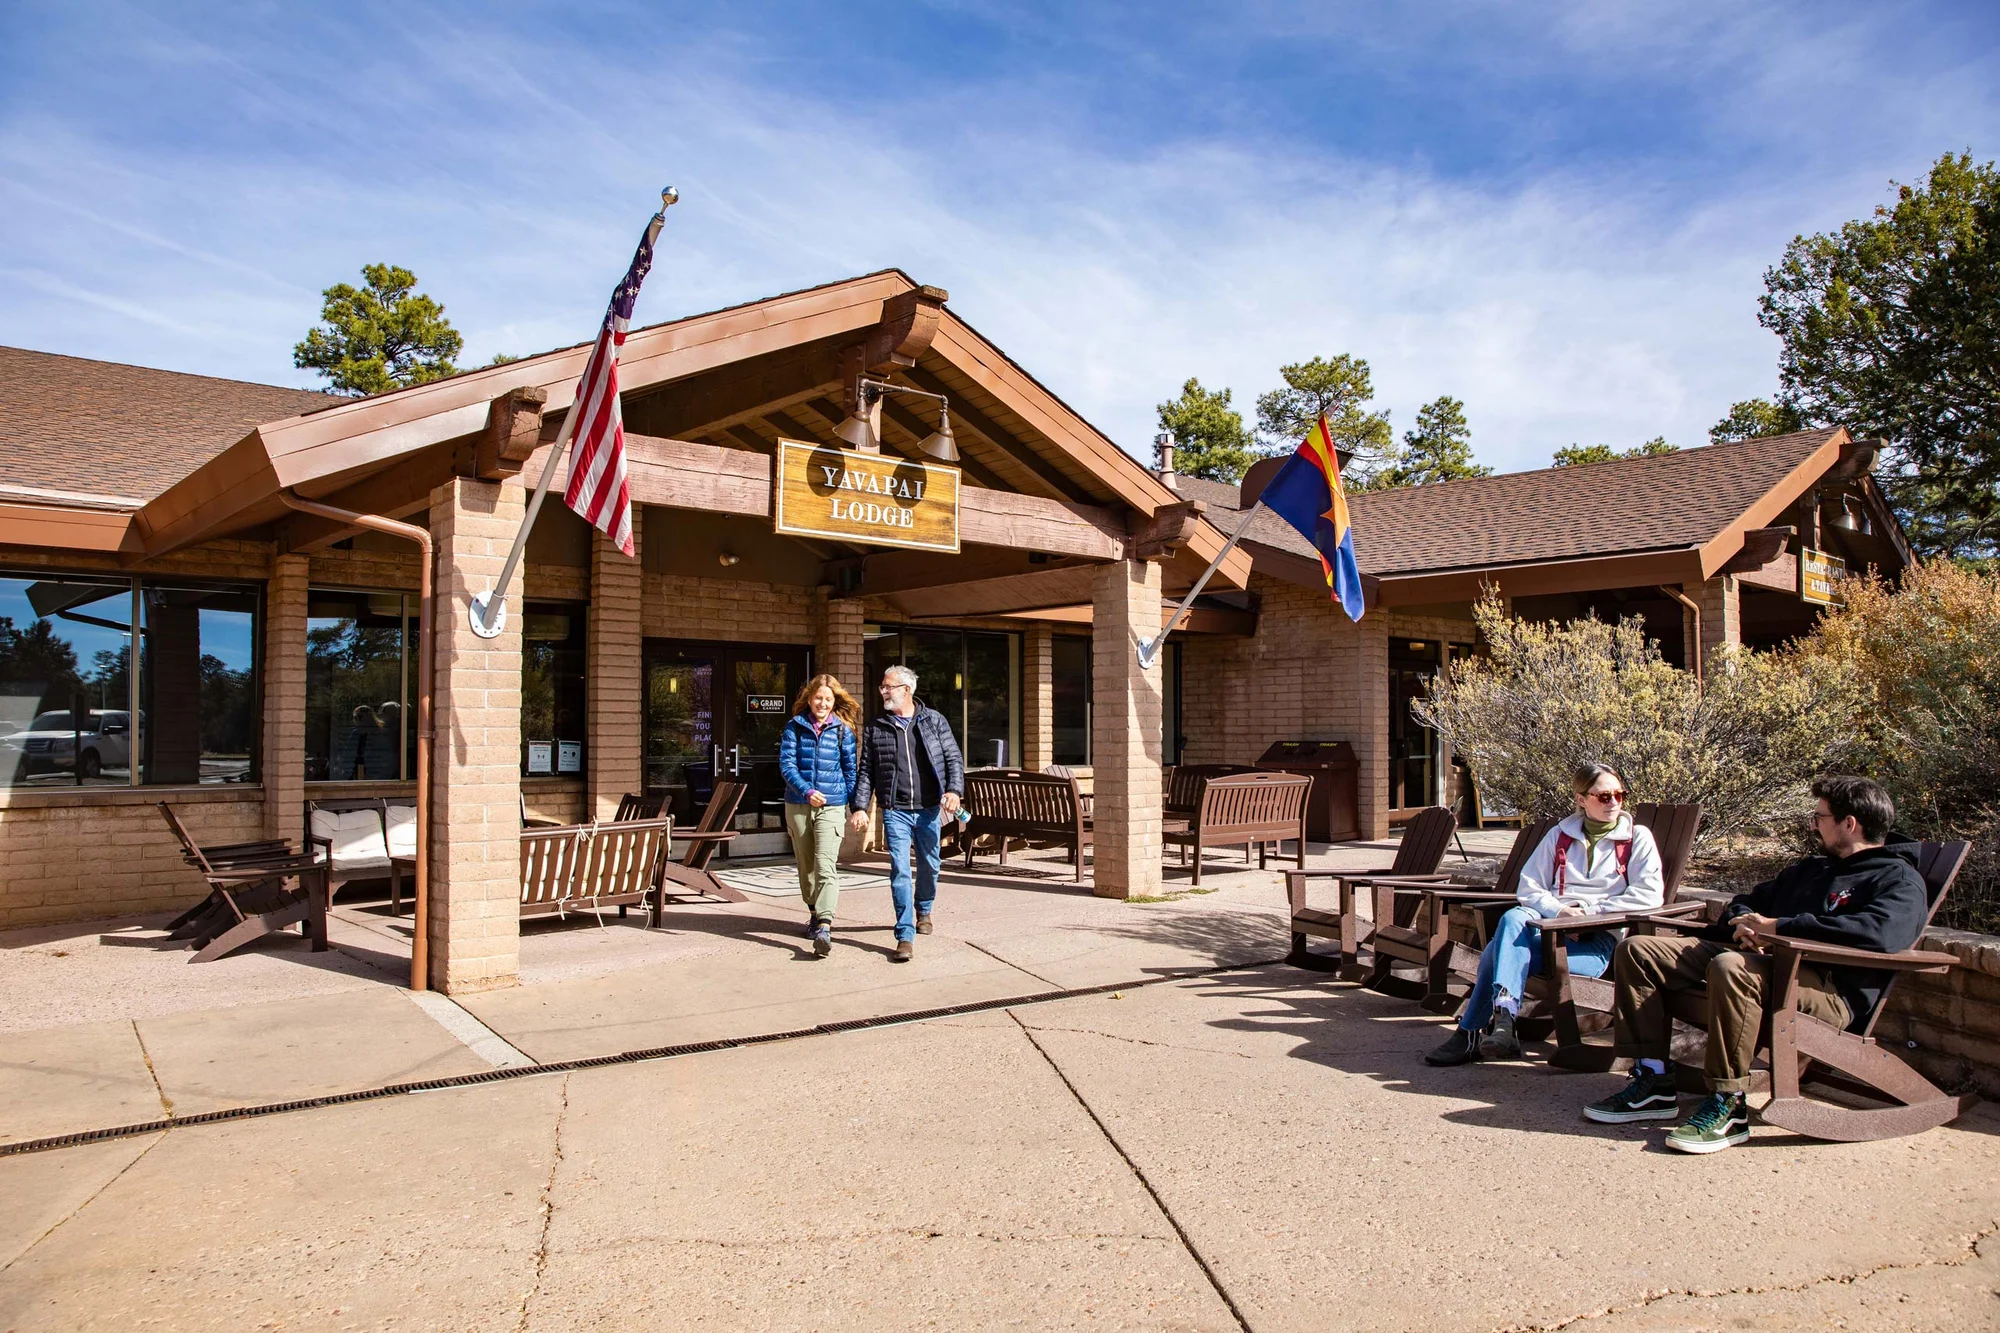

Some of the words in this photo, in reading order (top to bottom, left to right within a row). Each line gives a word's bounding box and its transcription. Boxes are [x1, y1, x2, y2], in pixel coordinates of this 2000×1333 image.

[821, 465, 924, 500] YAVAPAI
[830, 498, 914, 528] LODGE
[695, 722, 711, 730] YOU
